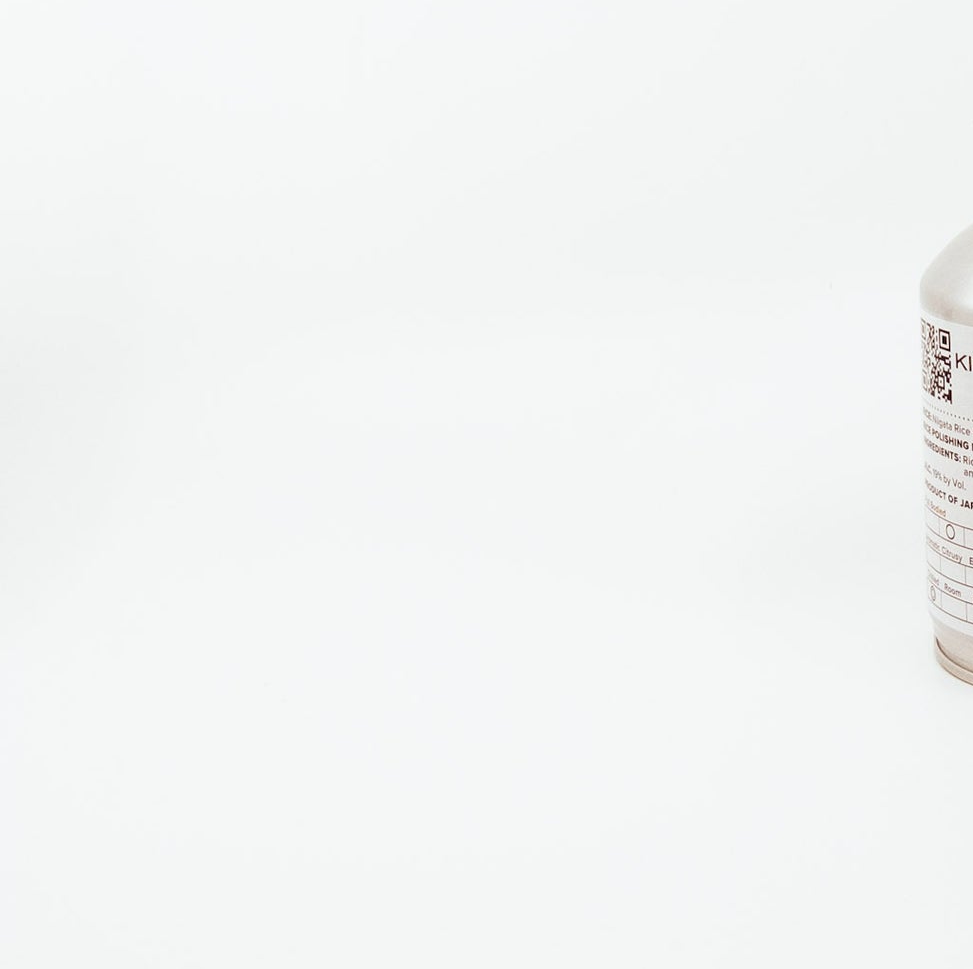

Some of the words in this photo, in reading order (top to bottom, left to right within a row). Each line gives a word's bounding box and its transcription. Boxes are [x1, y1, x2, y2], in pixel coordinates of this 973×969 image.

[954, 423, 971, 437] Rice
[932, 427, 970, 451] POLISHING
[952, 477, 967, 491] Vol.
[947, 494, 958, 505] OF
